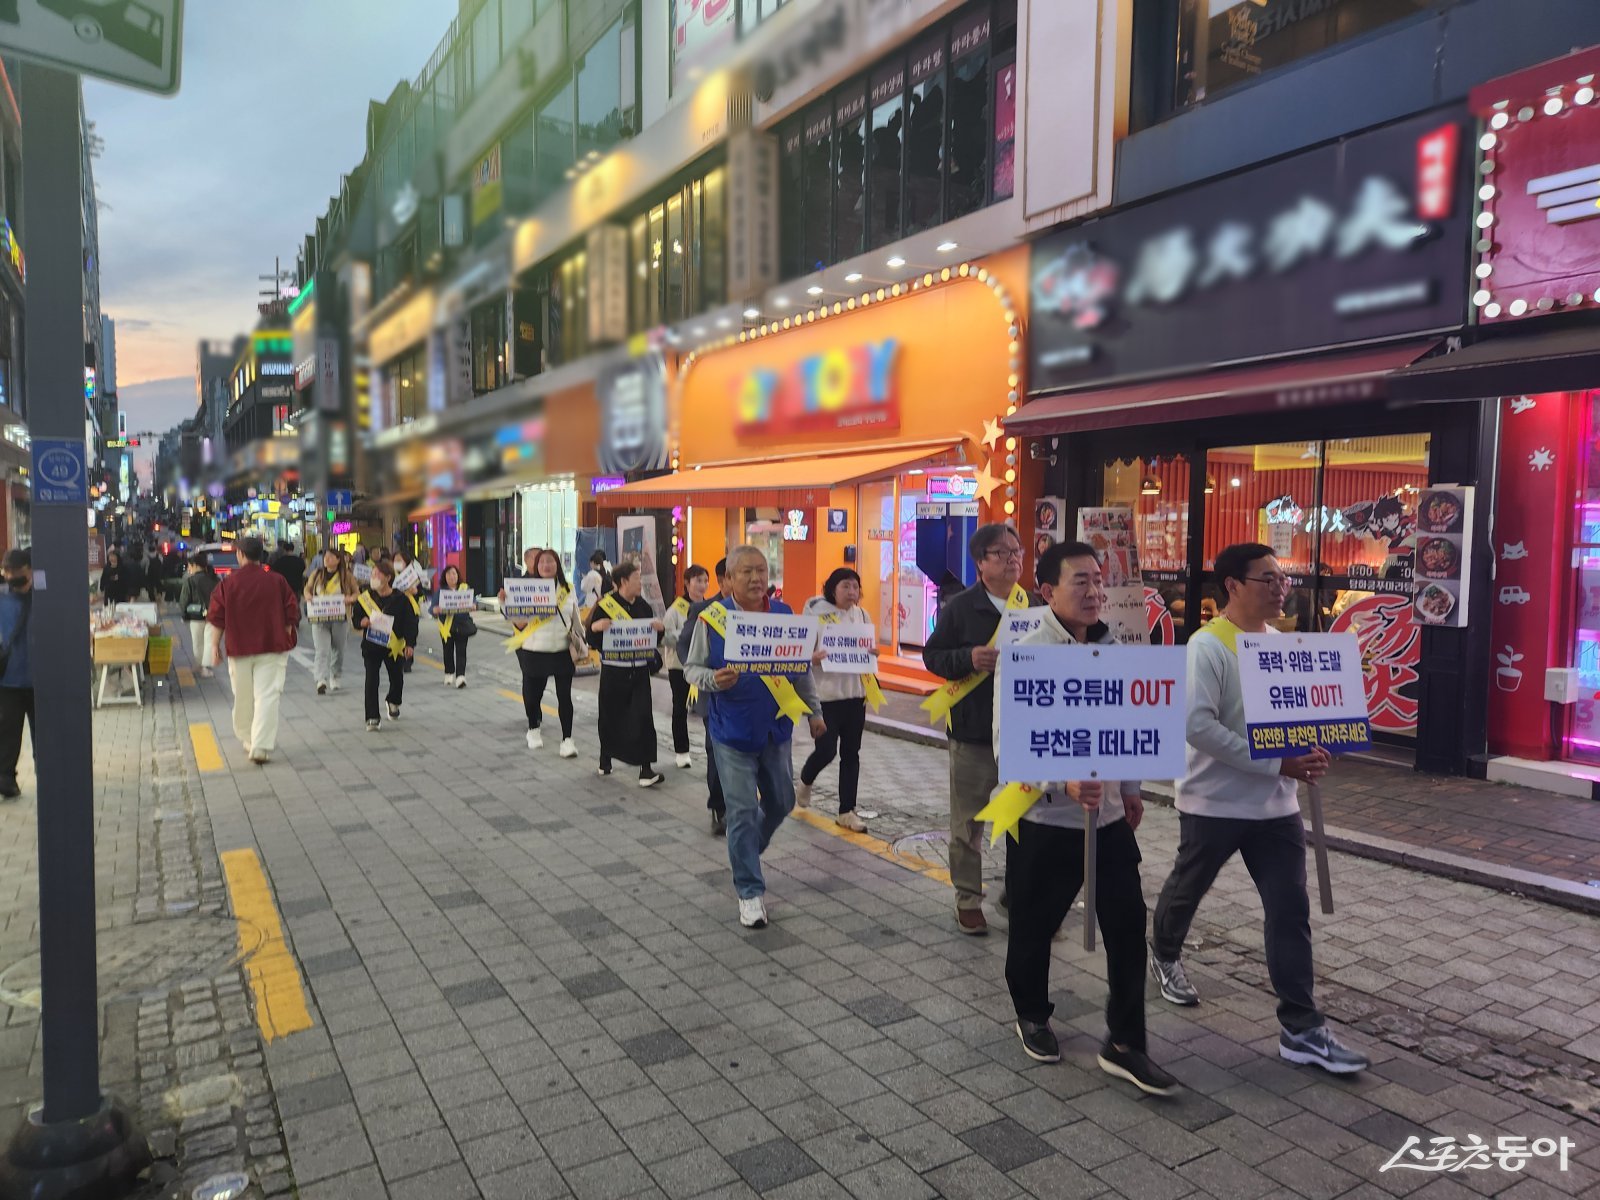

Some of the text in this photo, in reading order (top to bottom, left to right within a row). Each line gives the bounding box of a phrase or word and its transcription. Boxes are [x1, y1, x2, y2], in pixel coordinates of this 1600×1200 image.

[740, 643, 803, 658] 유튜버 OUT!
[858, 636, 873, 648] OUT
[1013, 678, 1176, 707] 막장 유튜버 OUT
[1269, 684, 1344, 710] 유튜버 OUT!
[1030, 728, 1160, 758] 부천을 떠나라
[1252, 721, 1369, 750] 안전한 부천역 지켜주세요
